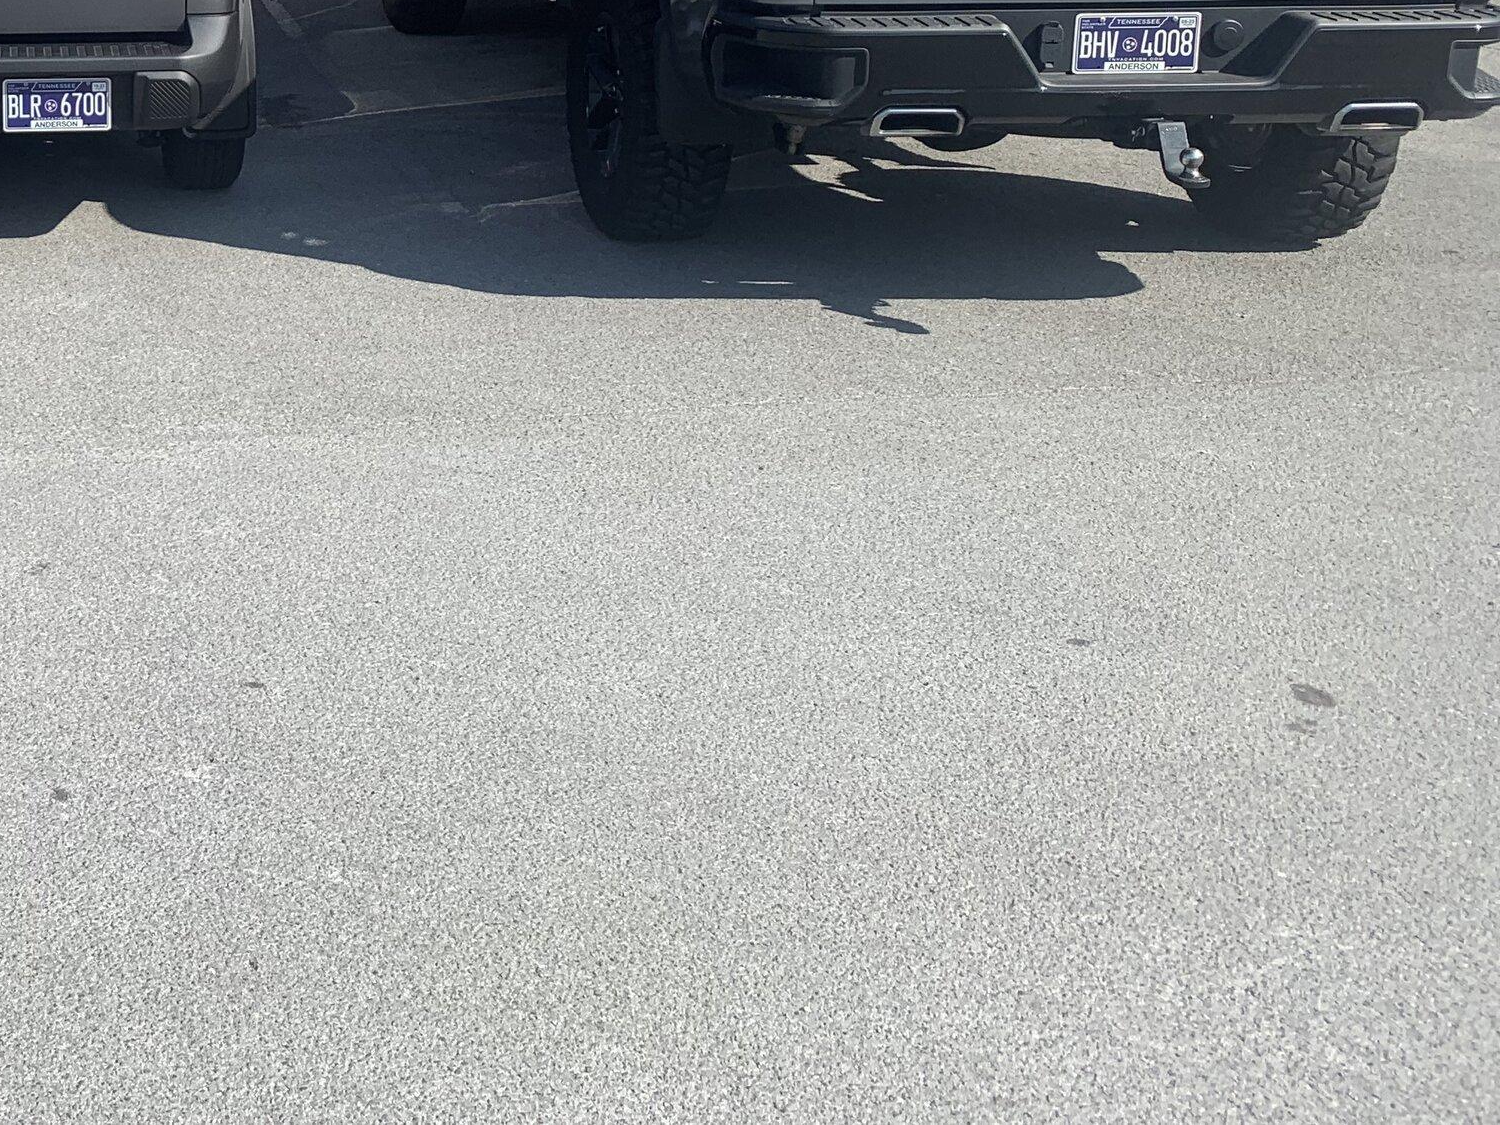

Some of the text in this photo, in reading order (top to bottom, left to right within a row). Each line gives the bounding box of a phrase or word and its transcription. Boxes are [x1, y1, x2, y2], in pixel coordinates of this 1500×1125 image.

[1079, 29, 1194, 59] BHV 4008
[1108, 63, 1160, 71] ANDERSON
[7, 92, 106, 119] BLR 6700
[34, 121, 79, 129] ANDERSON
